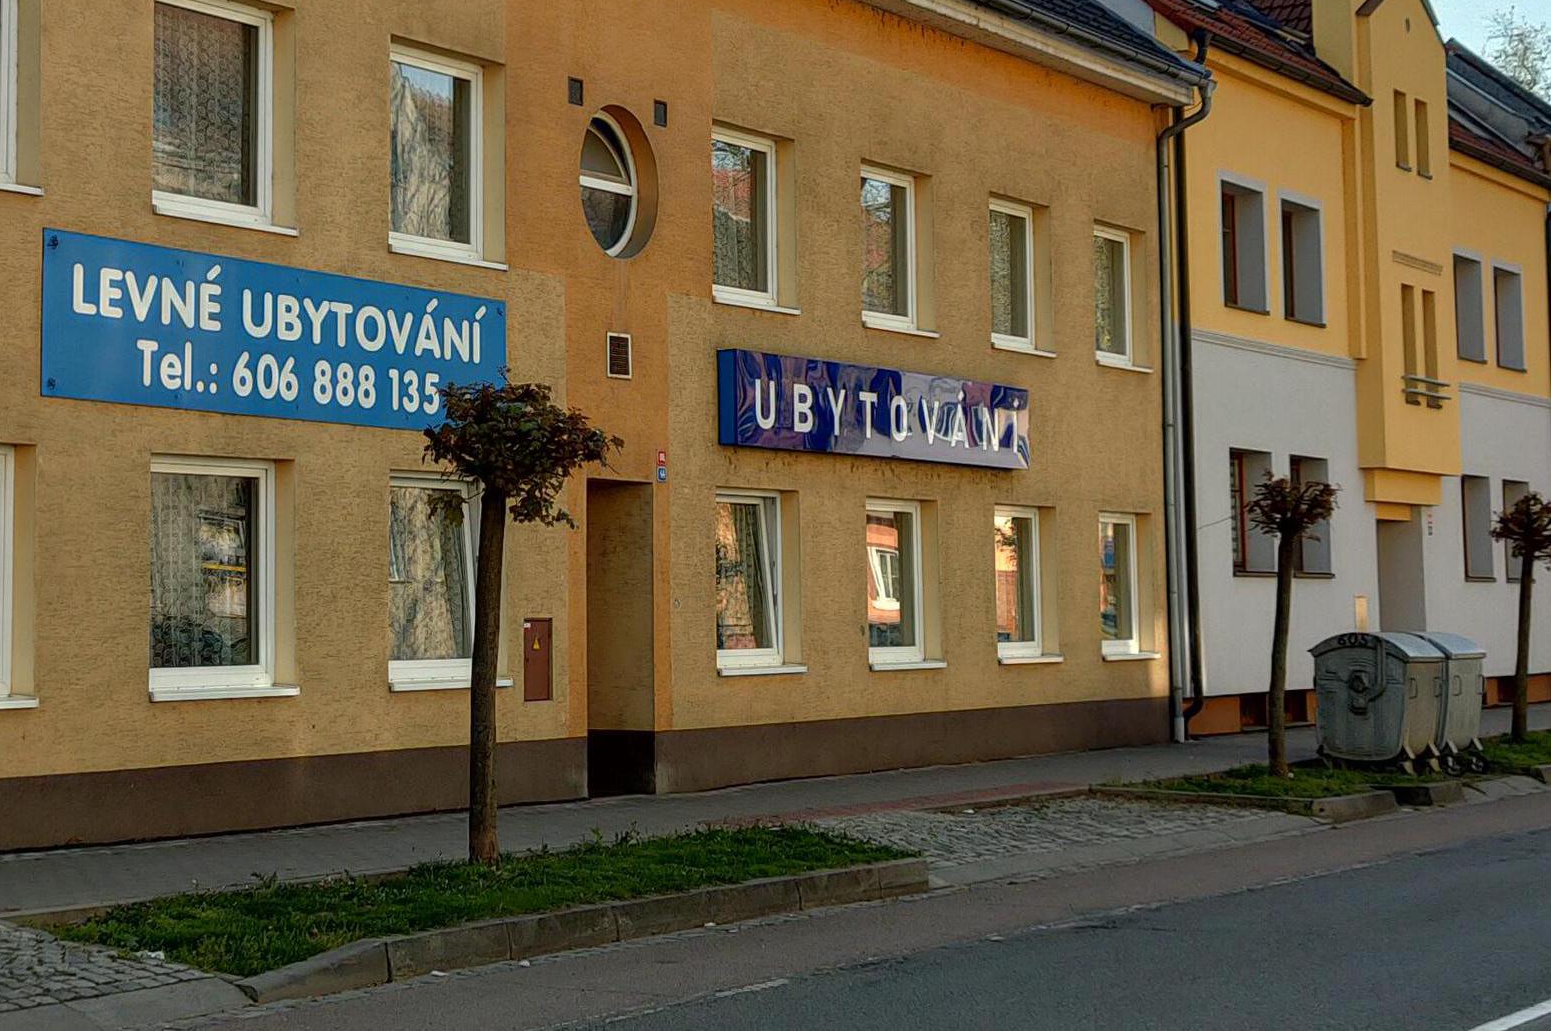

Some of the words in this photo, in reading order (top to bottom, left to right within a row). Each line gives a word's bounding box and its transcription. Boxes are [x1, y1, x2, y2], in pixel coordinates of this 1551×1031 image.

[72, 262, 223, 332] LEVNÉ
[242, 289, 487, 365] UBYTOVÁNÍ
[136, 339, 219, 394] Tel.:
[232, 351, 299, 402] 606
[313, 360, 377, 409] 888
[388, 368, 440, 415] 135
[755, 378, 1019, 454] UBYTOVÁNÍ
